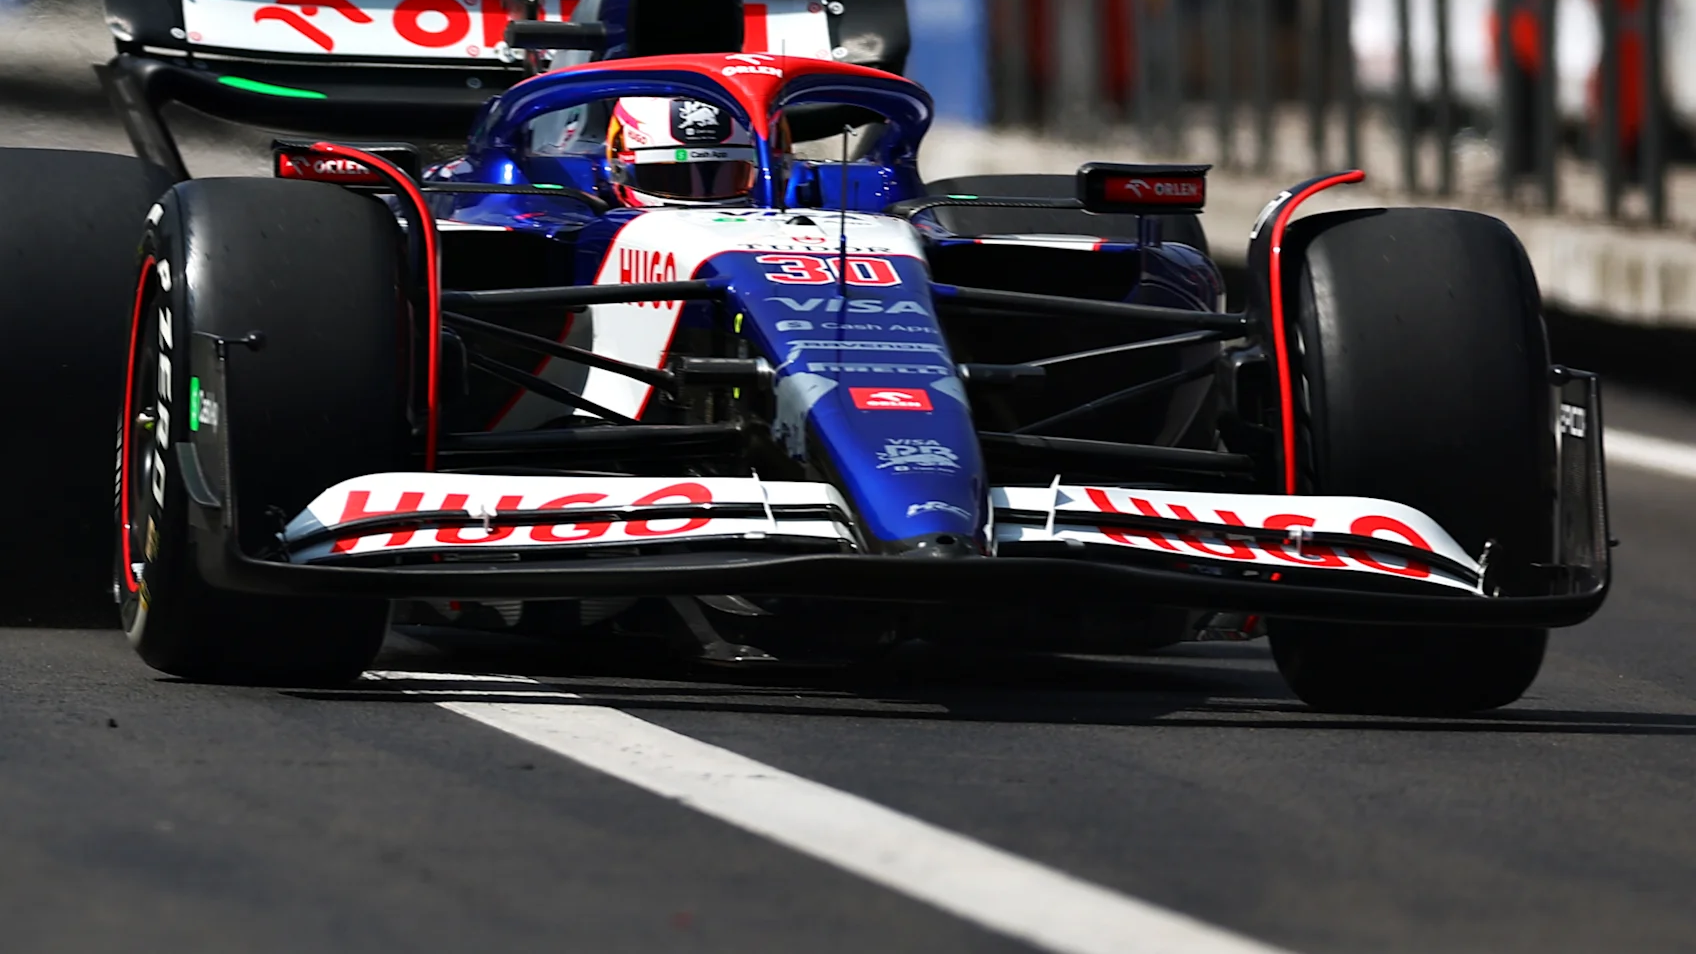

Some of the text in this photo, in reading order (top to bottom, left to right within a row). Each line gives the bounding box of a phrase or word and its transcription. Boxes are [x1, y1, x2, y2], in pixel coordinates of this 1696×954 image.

[1155, 182, 1197, 196] ORLEN
[620, 248, 676, 310] HUGO
[756, 254, 902, 286] 30
[763, 297, 929, 316] VISA
[821, 322, 883, 331] Cash
[152, 306, 173, 509] ZERO
[885, 438, 941, 446] VISA
[332, 483, 712, 553] HUGO
[1084, 488, 1433, 578] HUGO
